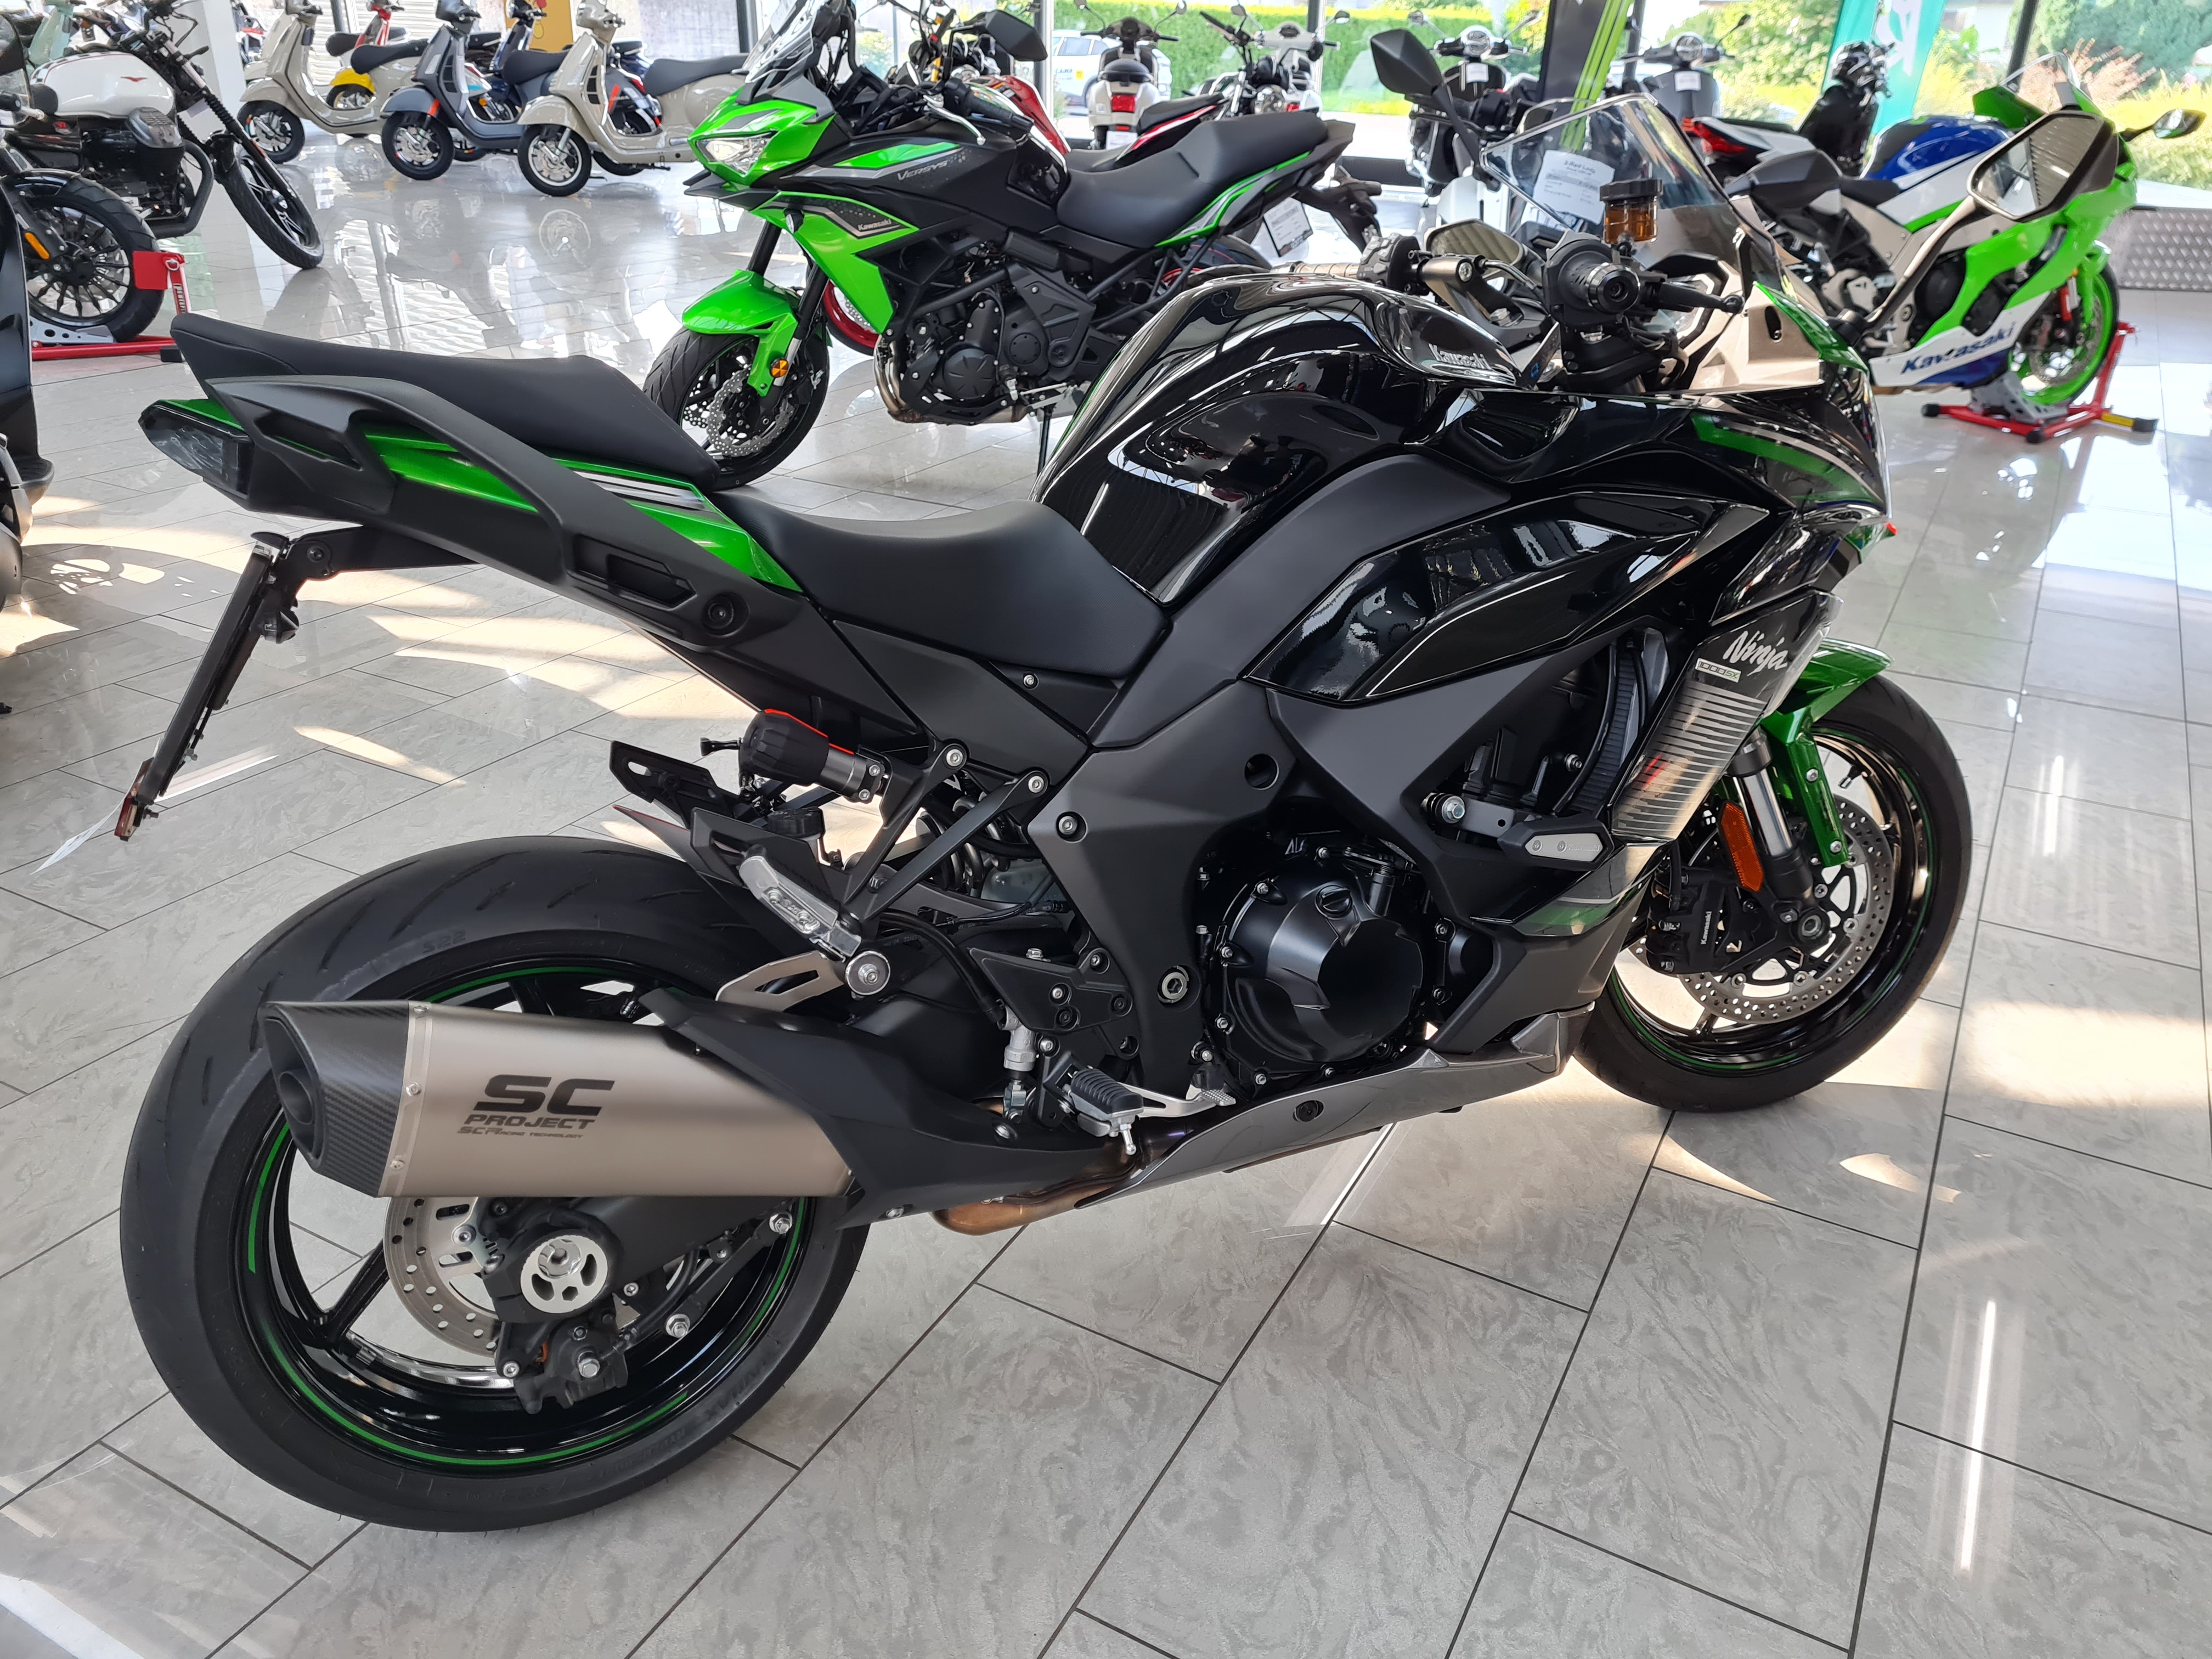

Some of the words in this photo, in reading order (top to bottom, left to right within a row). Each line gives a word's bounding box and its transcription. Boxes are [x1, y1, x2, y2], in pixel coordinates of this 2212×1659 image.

[896, 160, 948, 180] VERSYS
[857, 218, 891, 230] Kawasaki
[1428, 343, 1492, 370] Kawasaki
[1900, 321, 2016, 374] Kawasaki
[1723, 630, 1789, 677] Ninja
[1699, 661, 1740, 680] 1000SX
[1700, 911, 1712, 945] Kawasaki
[473, 1074, 615, 1116] SC
[464, 1114, 595, 1130] PROJECT
